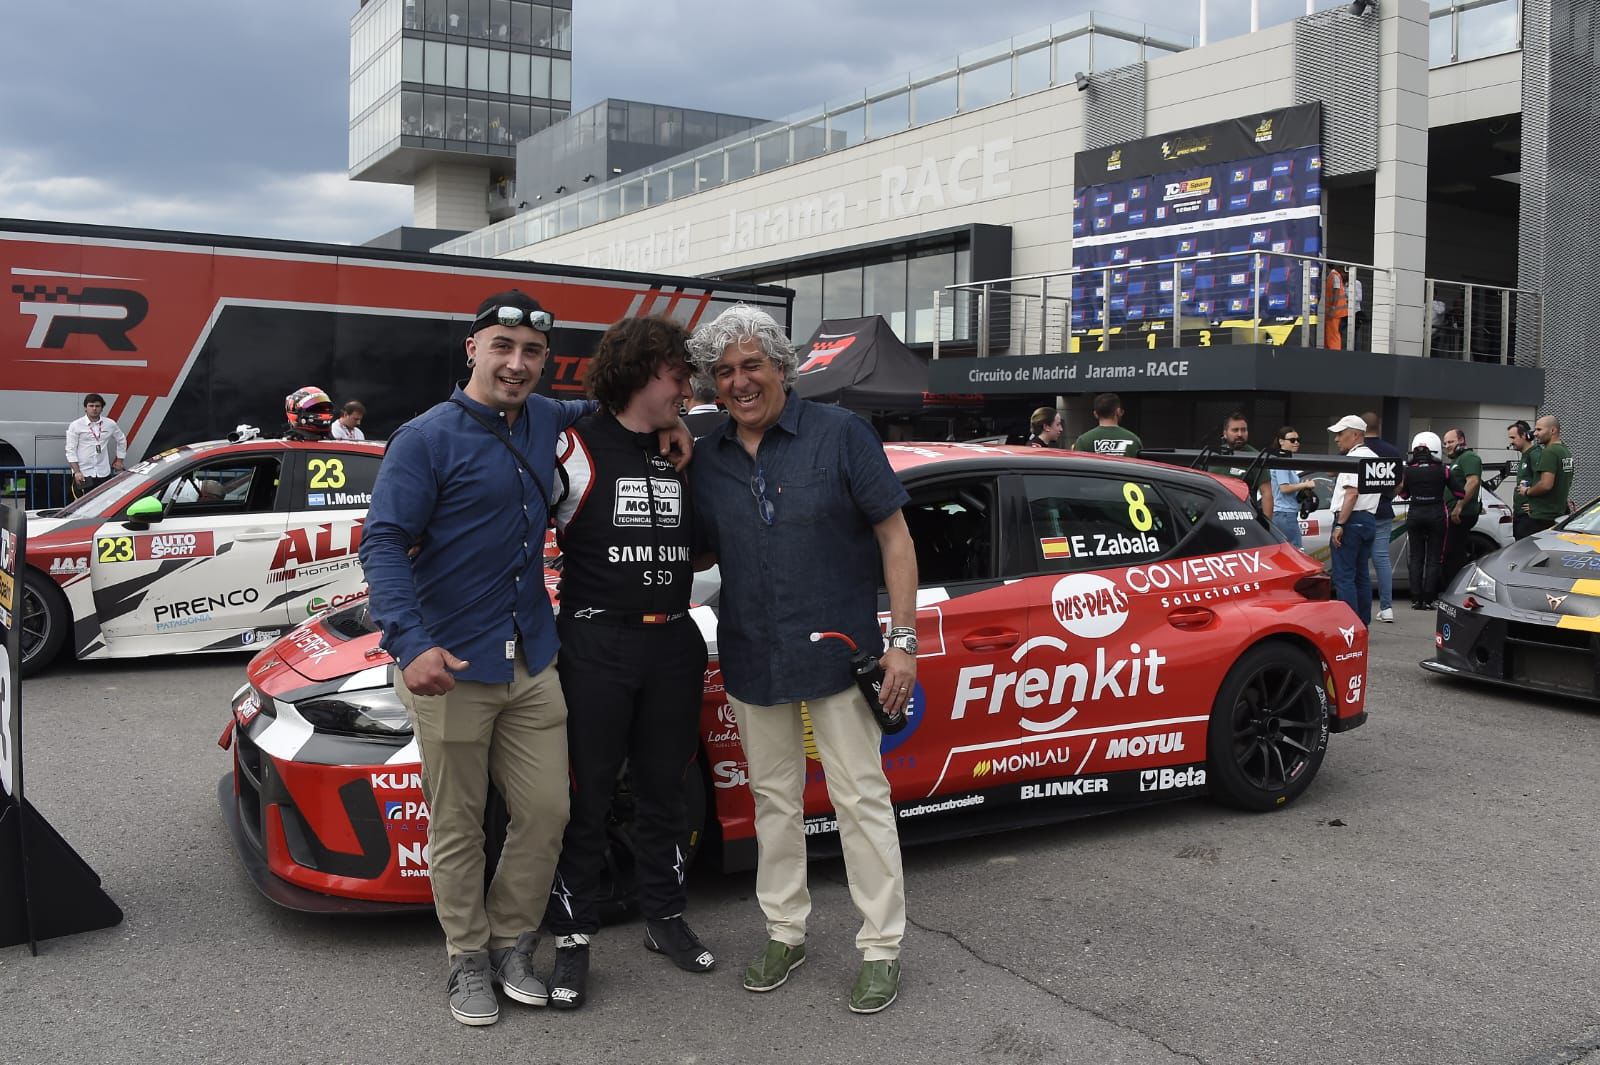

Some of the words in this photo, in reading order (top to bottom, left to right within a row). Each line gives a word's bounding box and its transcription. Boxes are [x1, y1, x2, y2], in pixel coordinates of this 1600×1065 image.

[608, 221, 691, 270] Madrid
[722, 192, 847, 252] Jarama
[879, 136, 1014, 221] RACE
[1146, 333, 1156, 350] 1
[1198, 330, 1212, 347] 3
[968, 369, 1012, 383] Circuito
[1014, 367, 1030, 381] de
[1032, 365, 1077, 380] Madrid
[1085, 364, 1136, 379] Jarama
[1147, 361, 1189, 377] RACE
[308, 458, 346, 489] 23
[1365, 462, 1397, 479] NGK
[625, 500, 673, 513] MOTUL
[1122, 482, 1153, 532] 8
[1217, 511, 1254, 521] SAMSUNG
[150, 533, 197, 548] AUTO
[1233, 527, 1246, 536] SSD
[98, 537, 135, 562] 23
[150, 545, 197, 558] SPORT
[1071, 533, 1160, 558] E.Zabala
[50, 556, 88, 570] JAS
[298, 561, 350, 578] Honda
[1125, 551, 1273, 594] COVERFIX
[153, 587, 259, 622] PIRENCO
[1161, 581, 1261, 608] Soluciones
[155, 613, 213, 631] PATAGONIA
[1335, 651, 1363, 662] CUPRA
[951, 642, 1167, 721] Frenkit
[1105, 732, 1185, 760] MOTUL
[992, 746, 1070, 775] MONLAU
[1020, 777, 1109, 800] BLINKER
[1158, 767, 1207, 790] Beta
[900, 796, 985, 818] cuatrocuatrosiete
[551, 989, 578, 1000] OMP
